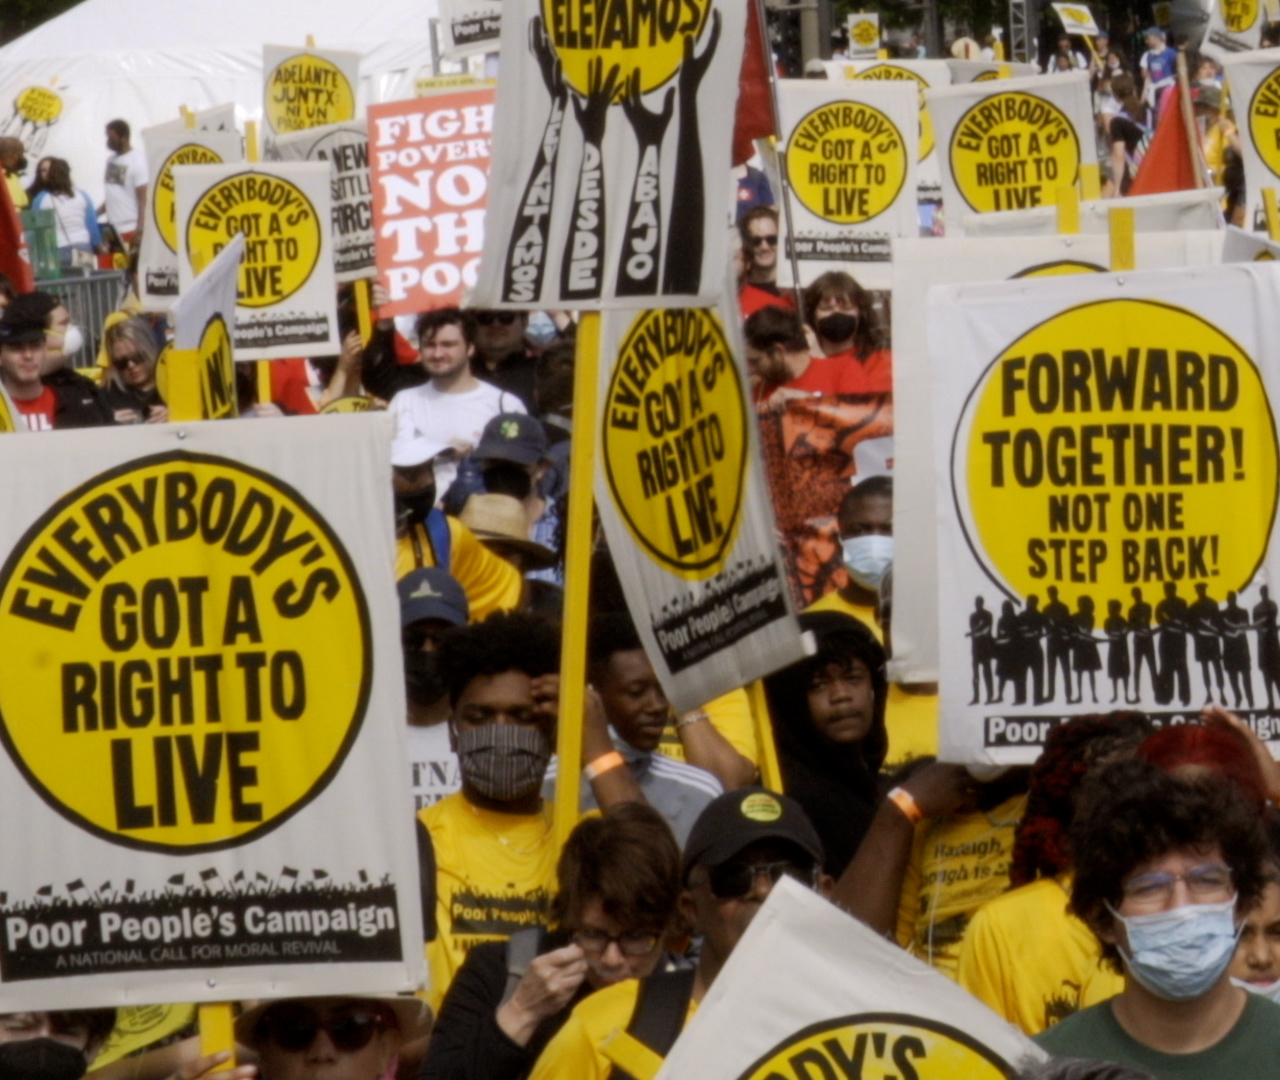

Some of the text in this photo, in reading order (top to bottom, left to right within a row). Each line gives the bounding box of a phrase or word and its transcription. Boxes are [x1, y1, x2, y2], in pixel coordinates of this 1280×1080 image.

[307, 108, 327, 119] UN
[375, 108, 494, 147] FIGH
[794, 105, 898, 154] EVERYBODY'S
[957, 94, 1069, 153] EVERYBODY'S
[822, 138, 872, 161] GOT A
[987, 132, 1041, 159] GOT A
[379, 165, 492, 216] NO
[809, 163, 885, 185] RIGHT TO
[977, 157, 1057, 188] RIGHT TO
[195, 177, 309, 231] EVERYBODY'S
[226, 213, 282, 238] GOT A
[567, 142, 600, 290] DESDE
[626, 144, 658, 279] ABAJO
[823, 188, 869, 217] LIVE
[274, 238, 298, 261] TO
[381, 213, 484, 263] TH
[816, 240, 858, 255] People's
[644, 368, 703, 440] GOT A
[1001, 347, 1240, 419] FORWARD
[636, 412, 725, 500] RIGHT TO
[982, 423, 1246, 489] TOGETHER!
[665, 473, 724, 559] LIVE
[1048, 493, 1184, 533] NOT ONE
[10, 472, 341, 633] EVERYBODY'S
[1027, 535, 1220, 584] STEP BACK!
[100, 575, 263, 652] GOT A
[658, 626, 689, 656] Poor
[61, 651, 307, 734] RIGHT TO
[988, 719, 1051, 744] Poor
[111, 730, 263, 831] LIVE
[7, 901, 396, 953] Poor People's Campaign
[453, 902, 486, 921] Poor
[150, 947, 185, 964] CALL
[223, 944, 278, 960] MORAL
[282, 940, 341, 957] REVIVAL
